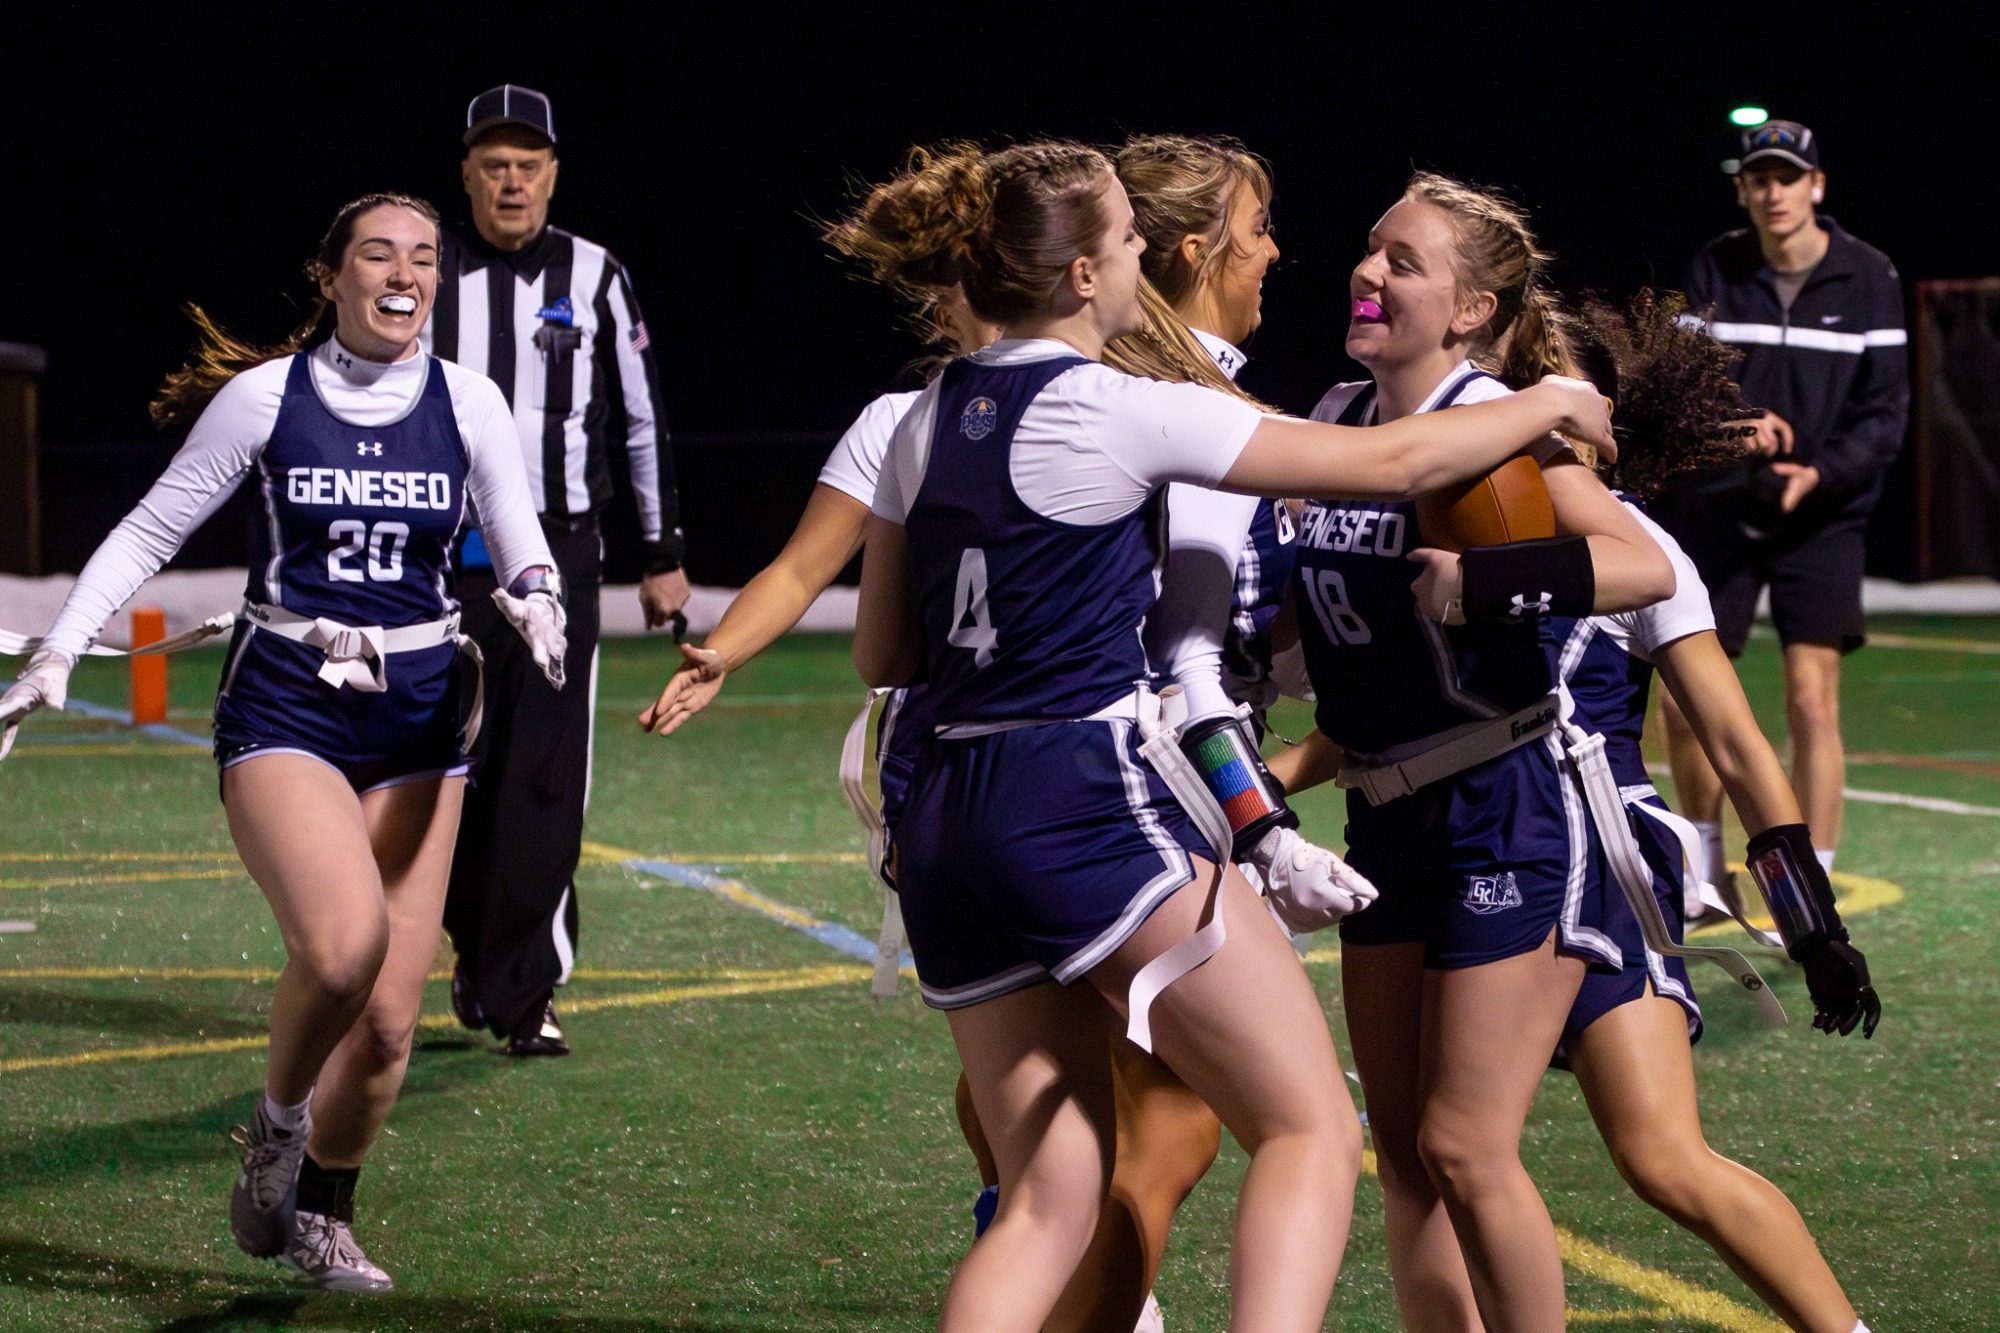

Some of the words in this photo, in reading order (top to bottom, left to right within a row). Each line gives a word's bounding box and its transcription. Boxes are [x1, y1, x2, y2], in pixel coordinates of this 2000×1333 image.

[287, 467, 451, 511] GENESEO
[327, 519, 410, 582] 20
[947, 547, 999, 670] 4
[1301, 566, 1372, 645] 18
